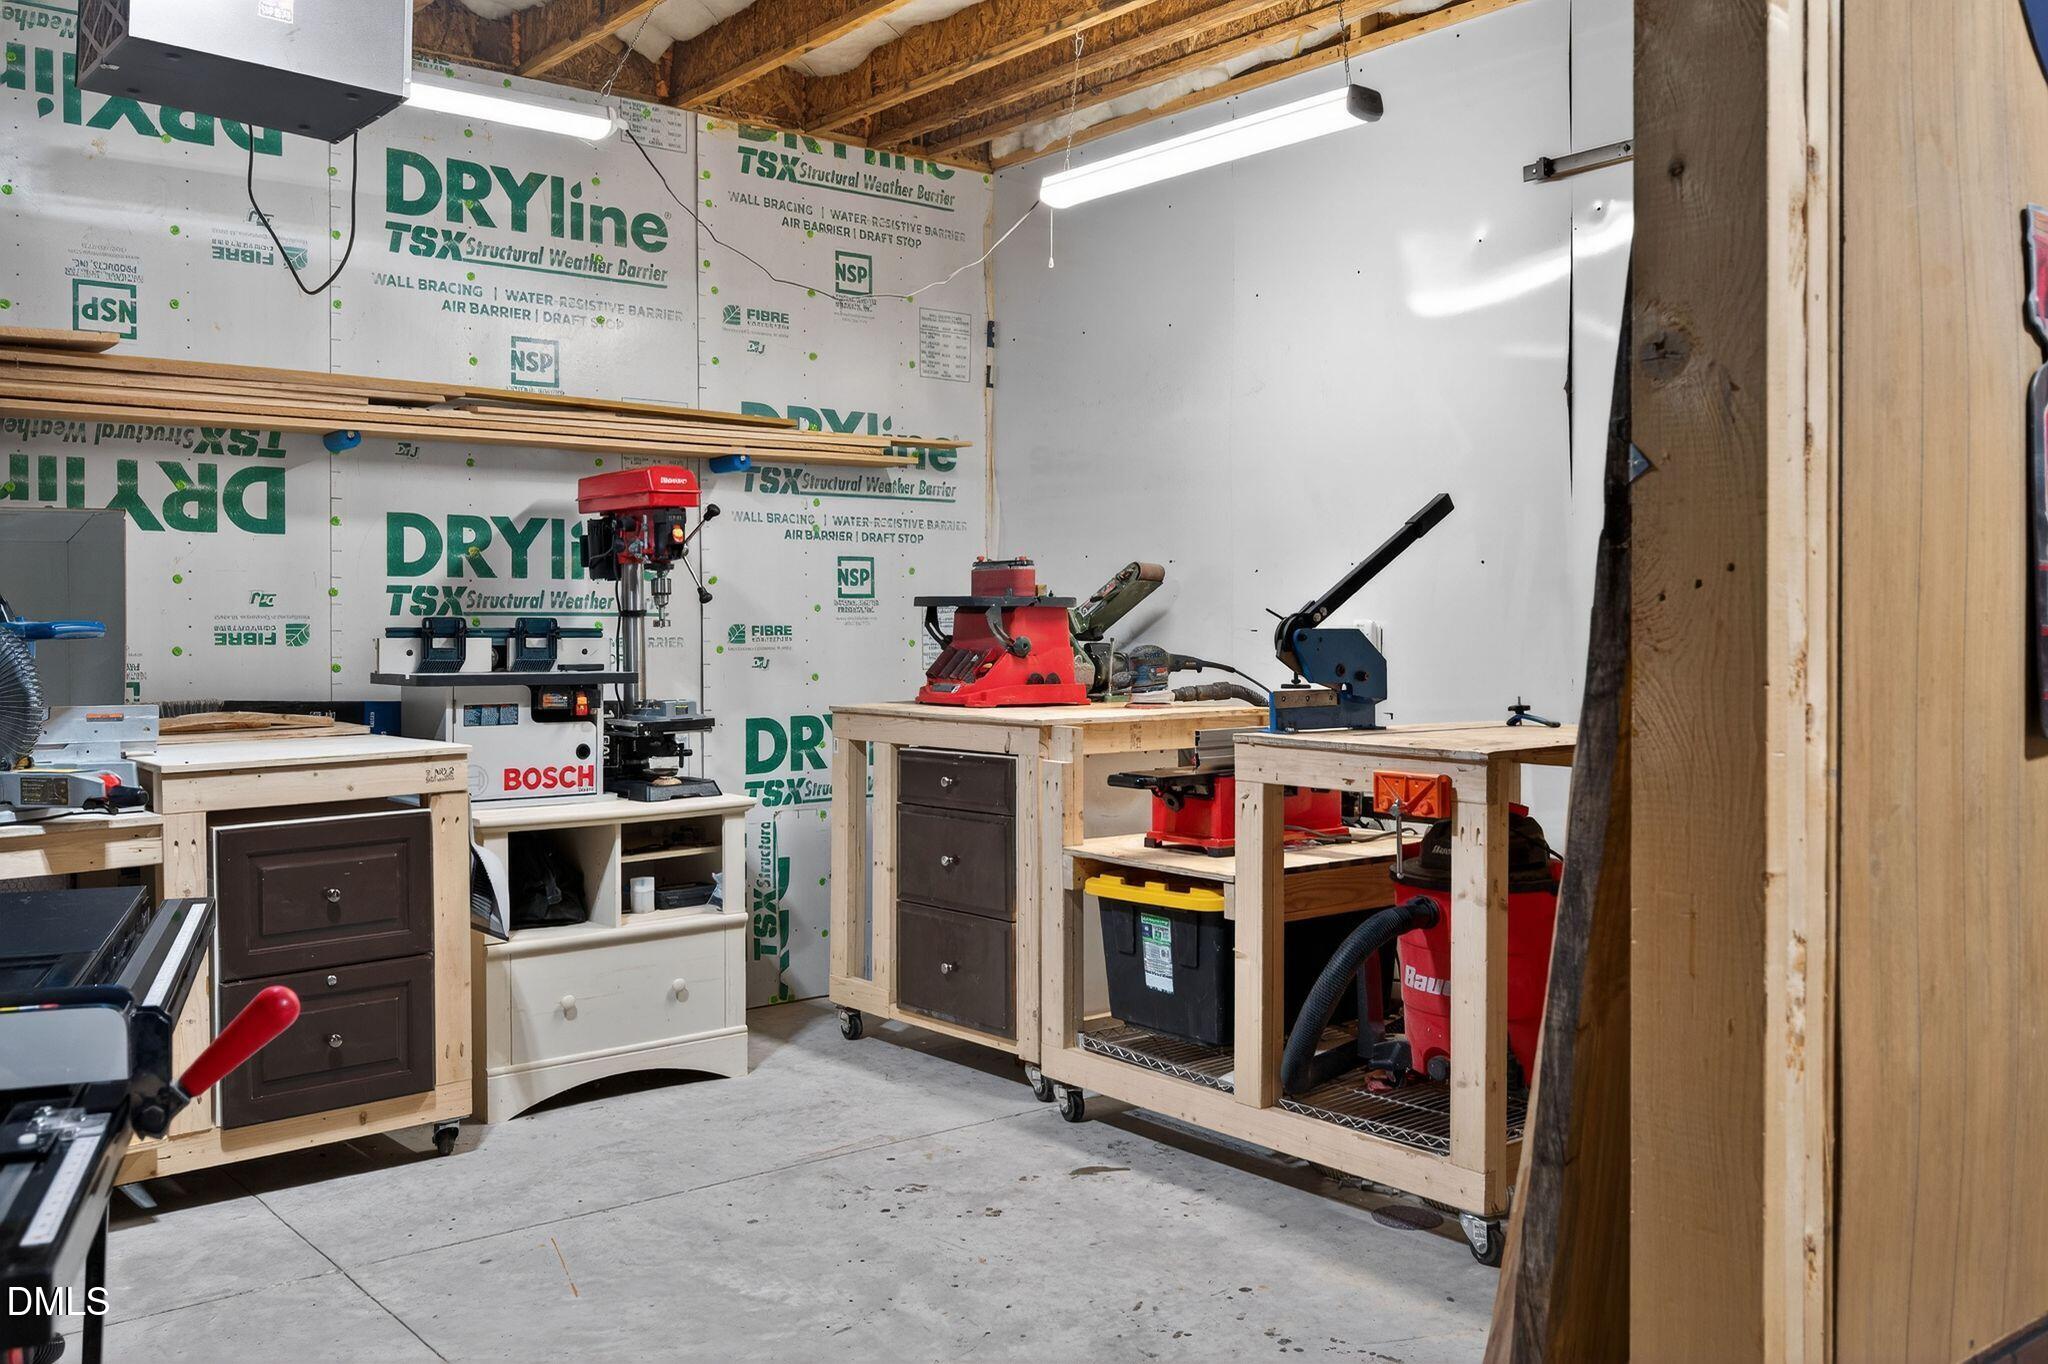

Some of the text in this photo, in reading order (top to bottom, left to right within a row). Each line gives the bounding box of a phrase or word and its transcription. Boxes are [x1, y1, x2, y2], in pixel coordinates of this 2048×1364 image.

[738, 145, 801, 183] TSX
[800, 161, 860, 188] Structural
[863, 173, 914, 198] Weather
[386, 147, 669, 253] DRYline
[728, 190, 760, 206] WALL
[763, 197, 814, 215] BRACING
[781, 216, 922, 249] AIR BARRIER DRAFT STOP
[212, 246, 274, 266] FIBRE
[384, 221, 669, 283] TSX Structural Weather Barrier
[835, 263, 868, 283] NSP
[82, 297, 137, 324] NSP
[372, 272, 415, 289] WALL
[418, 278, 484, 298] BRACING
[628, 304, 685, 323] BARRIER
[441, 299, 468, 313] AIR
[470, 302, 531, 320] BARRIER
[543, 311, 588, 327] DRAFT
[746, 308, 790, 324] FIBRE
[511, 349, 553, 373] NSP
[94, 422, 195, 449] Structural
[193, 427, 287, 458] TSX
[744, 465, 957, 498] TSX Structural Weather Barrier
[731, 510, 763, 522] WALL
[766, 512, 815, 525] BRACING
[926, 519, 968, 532] BARRIER
[784, 529, 924, 544] AIR BARRIER DRAFT STOP
[837, 568, 870, 587] NSP
[386, 585, 615, 616] TSX Structural Weather
[214, 632, 277, 646] FIBRE
[752, 625, 793, 636] FIBRE
[503, 765, 595, 791] BOSCH
[744, 777, 807, 807] TSX
[753, 887, 778, 961] TSX
